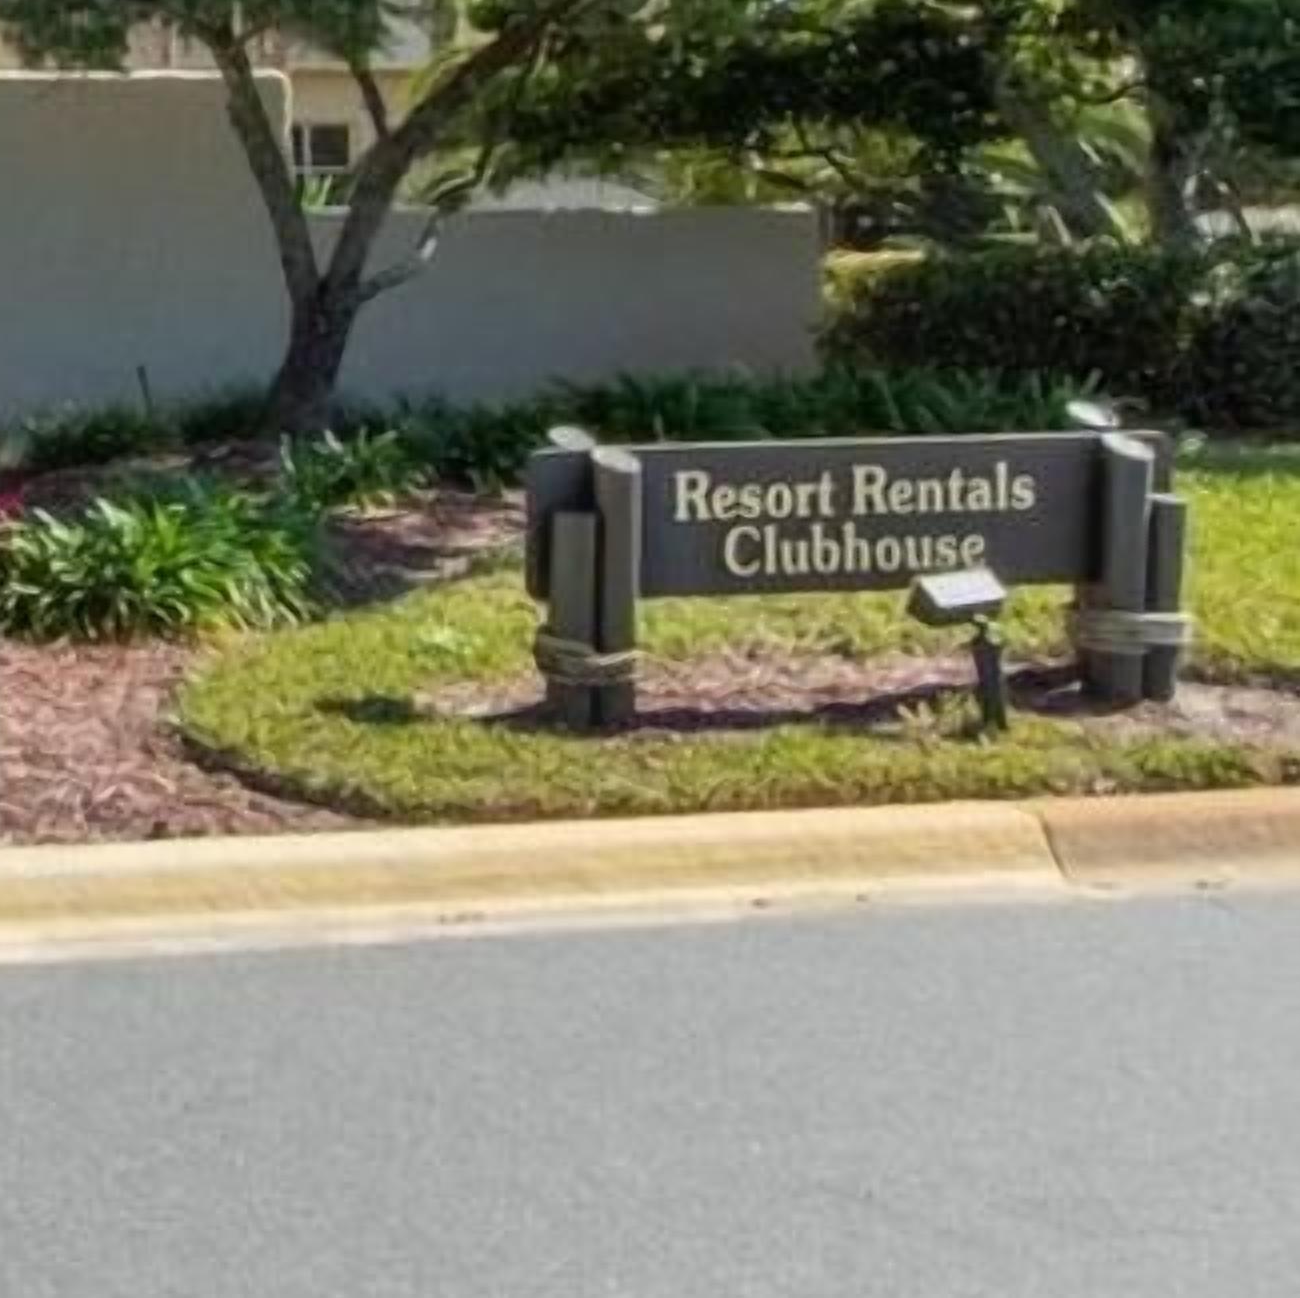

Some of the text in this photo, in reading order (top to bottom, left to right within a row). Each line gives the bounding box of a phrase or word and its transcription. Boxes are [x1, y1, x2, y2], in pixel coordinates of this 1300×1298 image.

[674, 461, 1037, 521] Resort Rentals
[723, 522, 987, 576] Clubhouse
